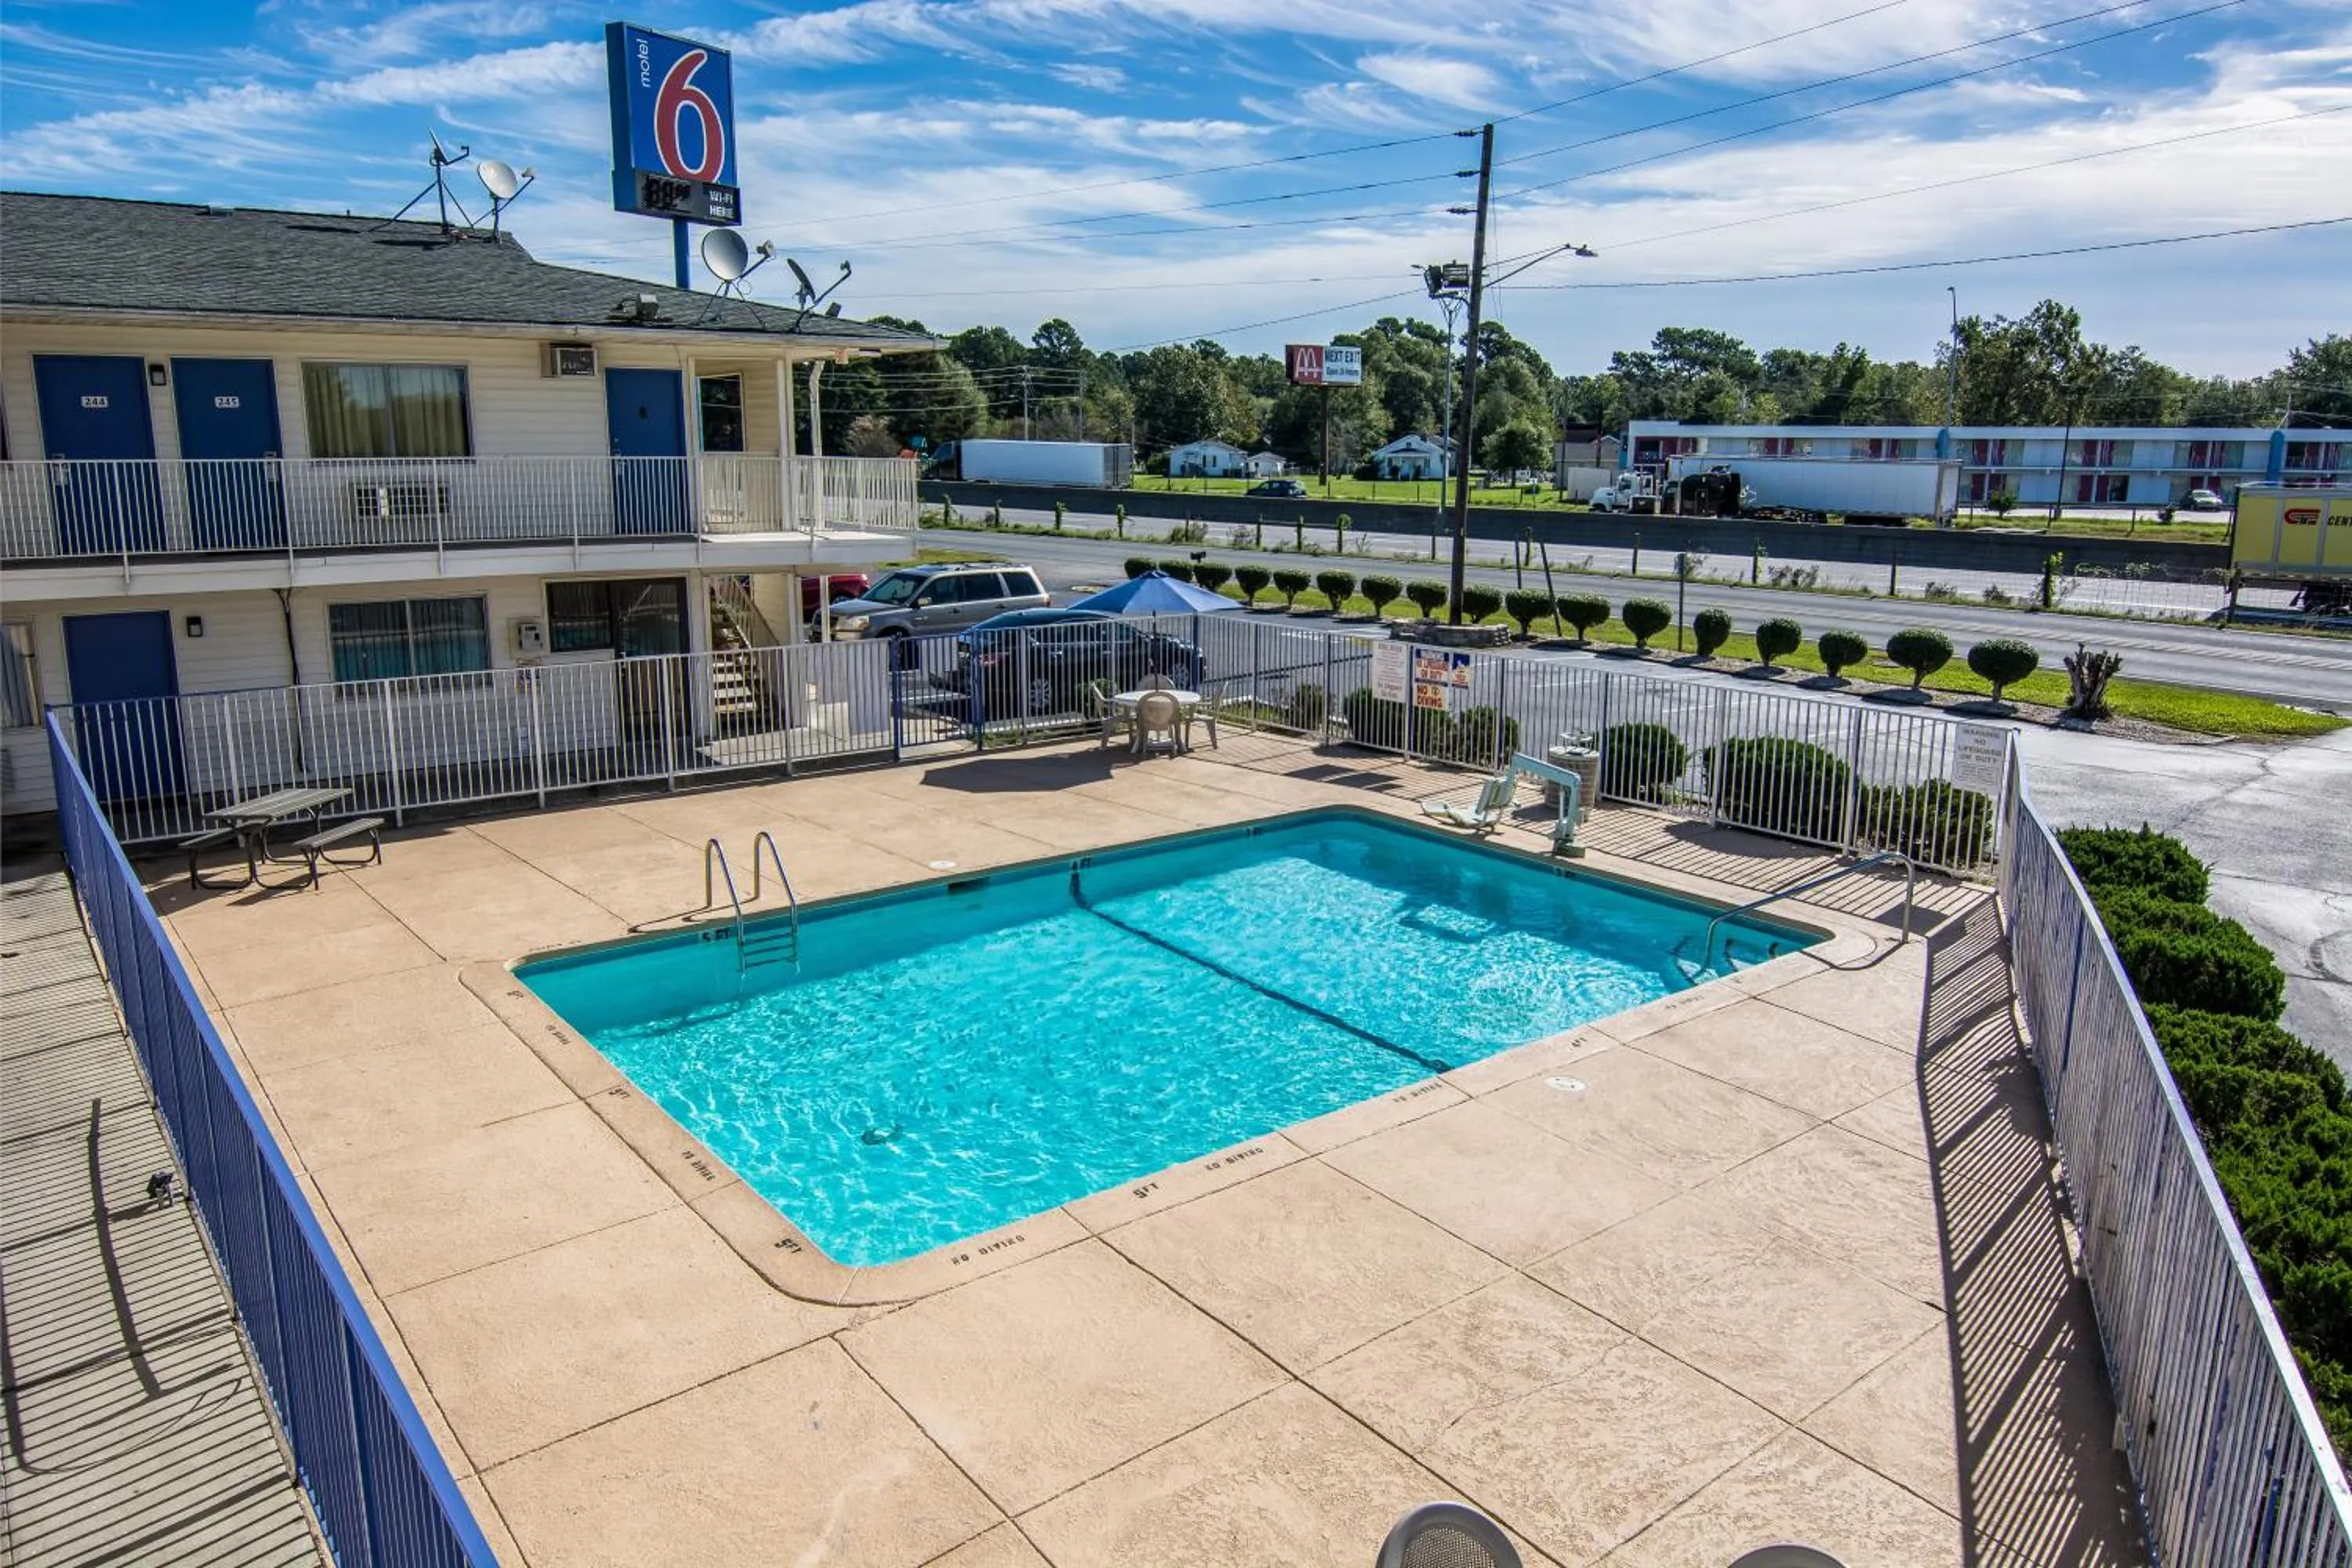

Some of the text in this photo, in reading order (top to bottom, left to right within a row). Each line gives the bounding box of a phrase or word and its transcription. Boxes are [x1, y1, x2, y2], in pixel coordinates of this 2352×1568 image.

[636, 38, 651, 88] motel
[654, 48, 725, 184] 6
[709, 190, 734, 204] WI-FI
[709, 205, 735, 219] HERE
[1345, 350, 1360, 363] EXIT
[1417, 684, 1428, 695] NO
[1417, 695, 1443, 708] DIVING
[978, 1234, 1026, 1255] DIVING
